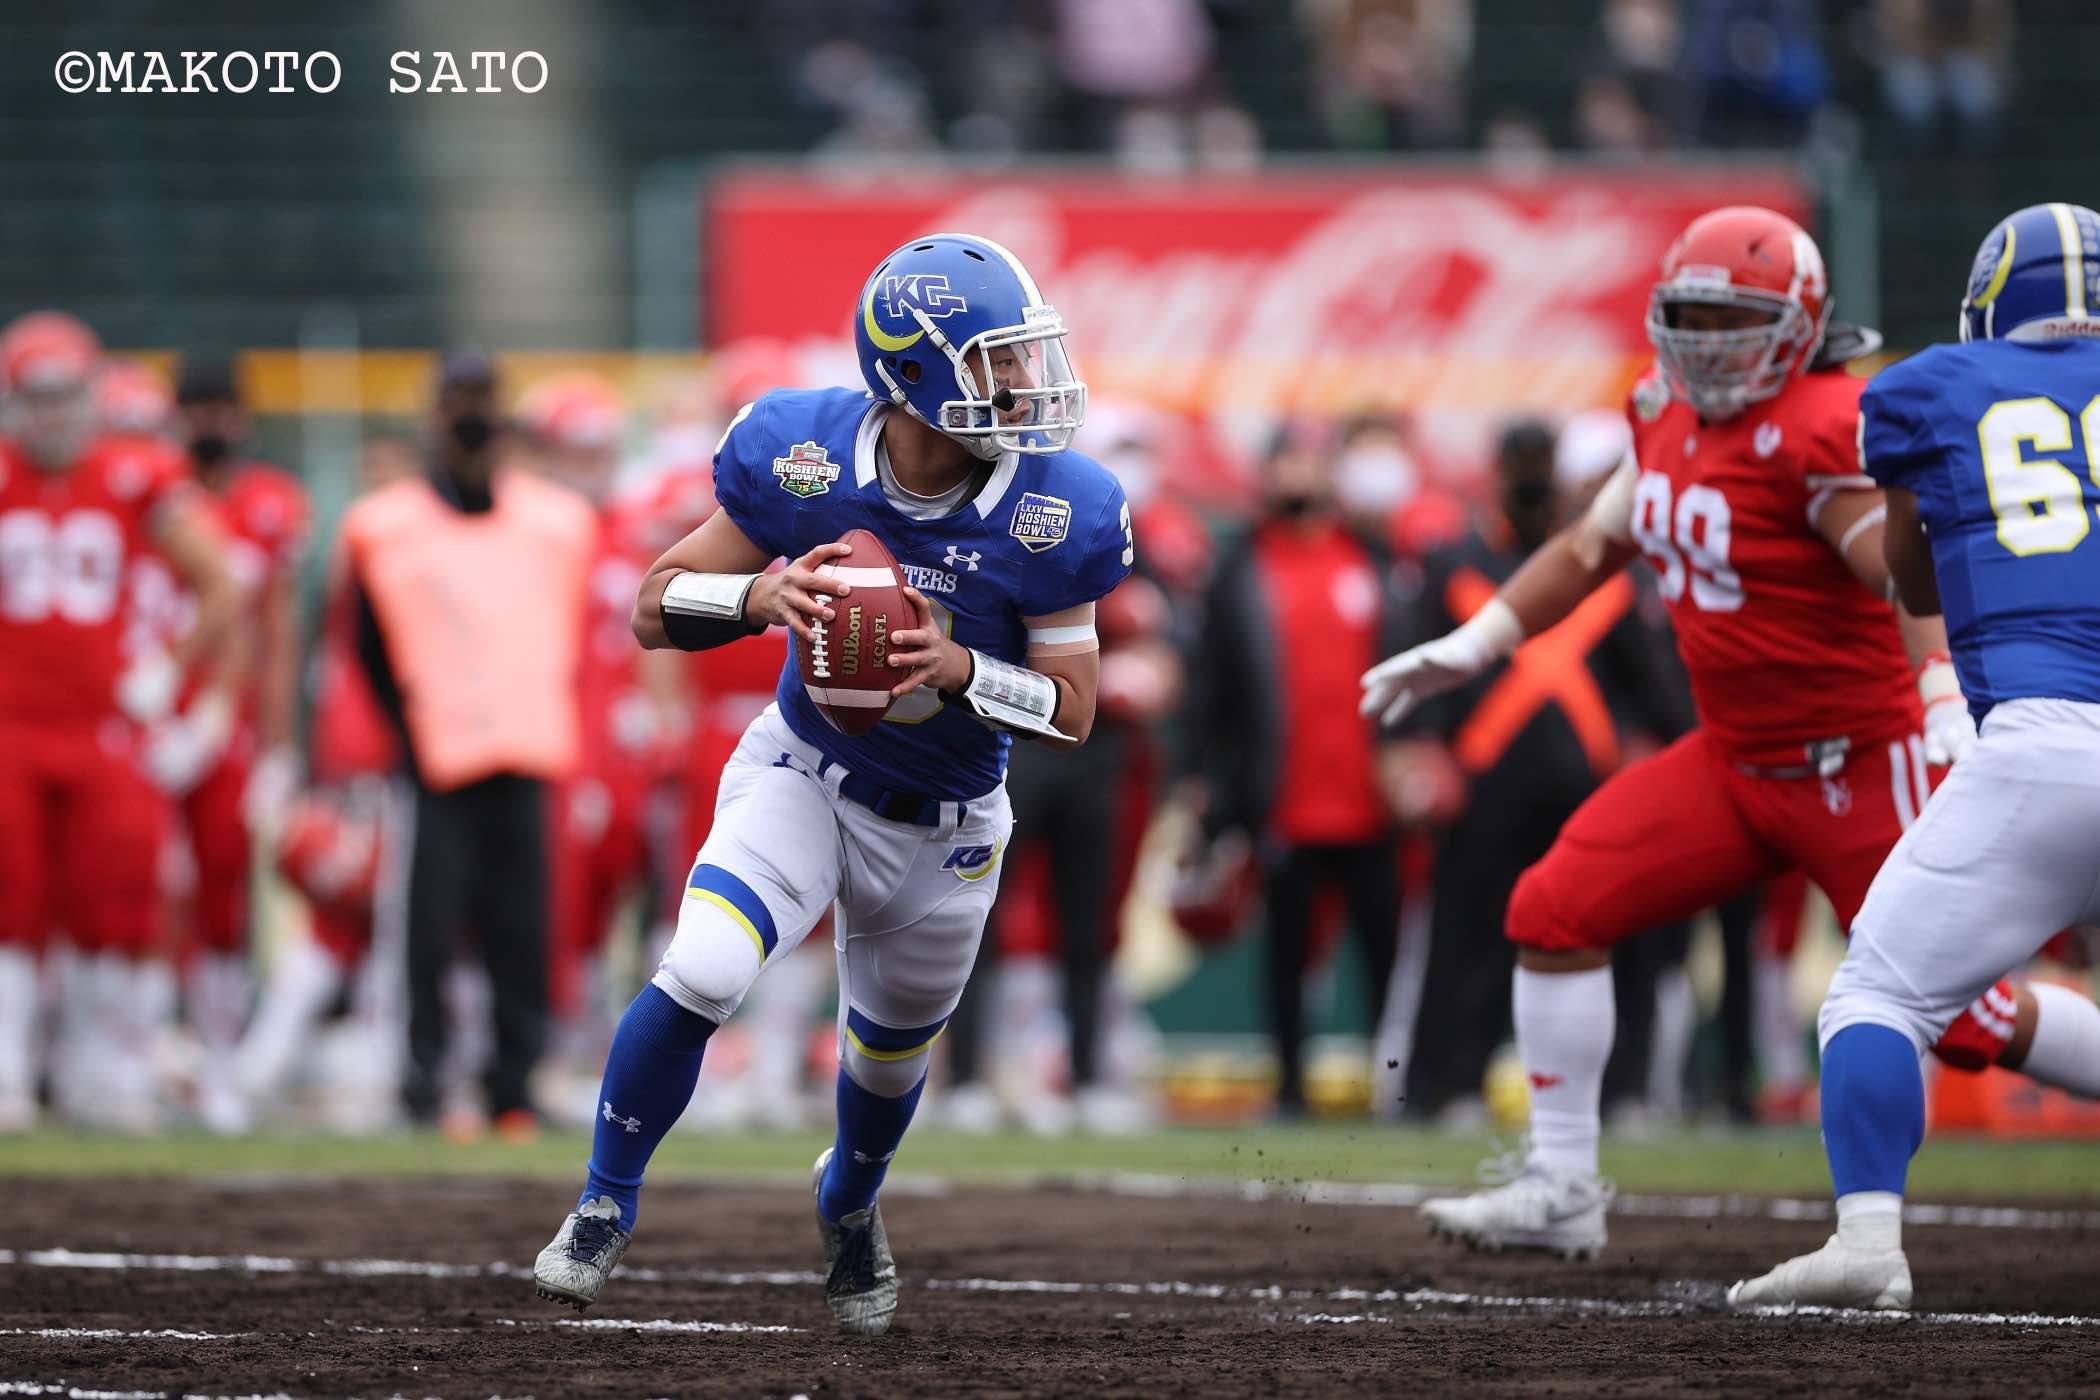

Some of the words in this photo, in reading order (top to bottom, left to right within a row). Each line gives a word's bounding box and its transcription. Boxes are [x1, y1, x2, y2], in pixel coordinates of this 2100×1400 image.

[886, 274, 968, 318] KG
[775, 461, 837, 478] KOSHIEN
[789, 473, 820, 482] BOWL
[1976, 395, 2100, 558] 6
[1018, 512, 1066, 528] KOSHIEN
[1020, 503, 1043, 514] LXXV
[1014, 523, 1048, 537] BOWL
[1631, 469, 1747, 613] 99
[899, 563, 958, 594] TERS
[843, 605, 862, 675] Wilson
[873, 614, 887, 668] KCAFL
